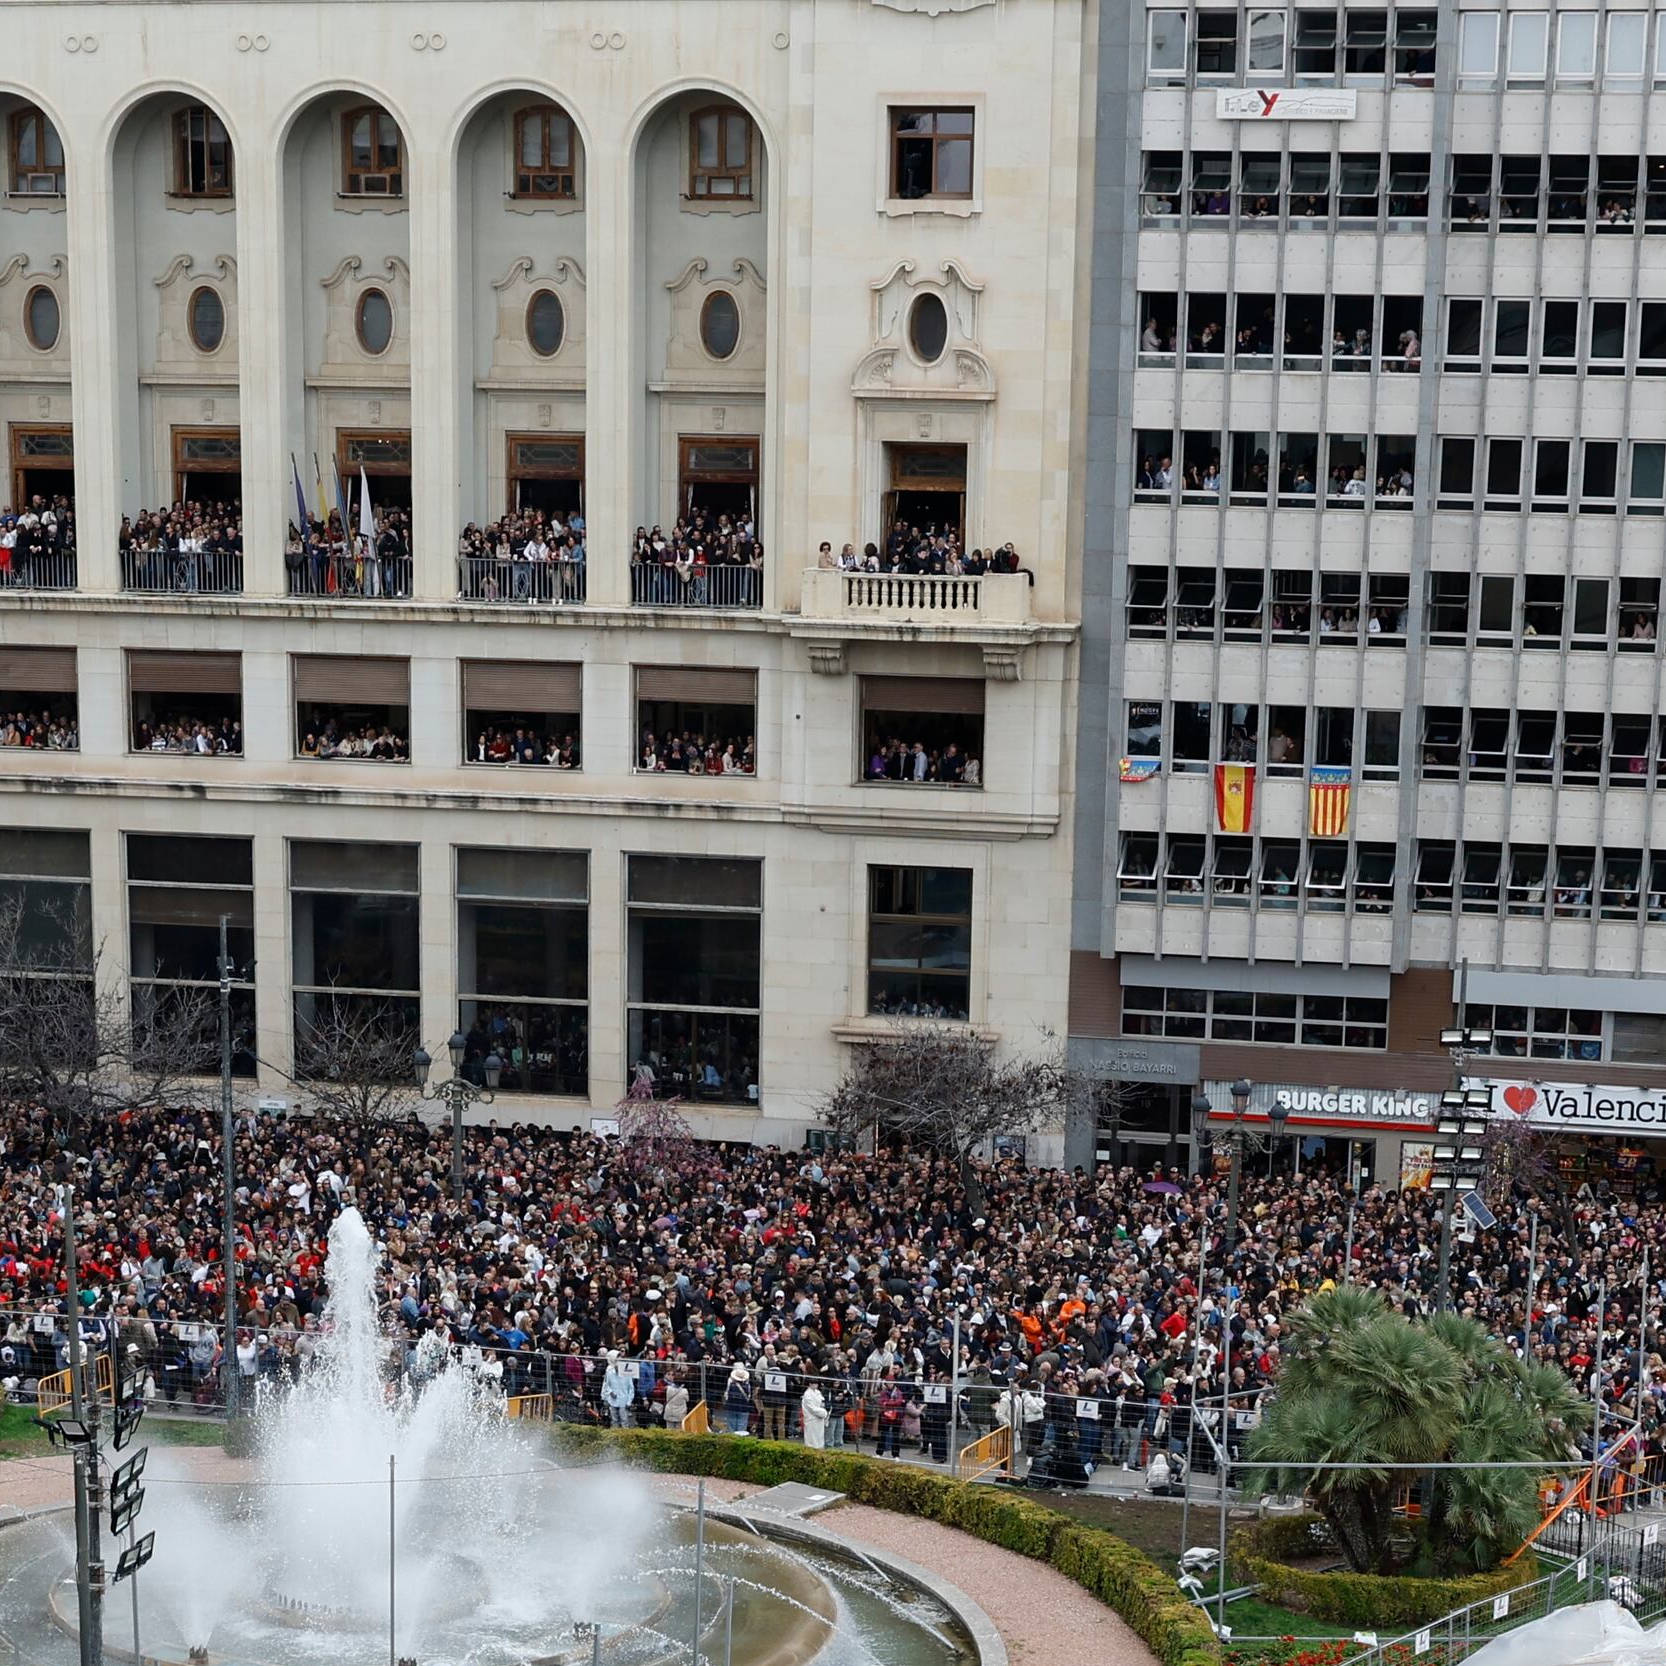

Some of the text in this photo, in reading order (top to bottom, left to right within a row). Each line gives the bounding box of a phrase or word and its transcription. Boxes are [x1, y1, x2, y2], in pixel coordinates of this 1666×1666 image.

[1132, 1062, 1178, 1076] BAYARRI
[1276, 1090, 1429, 1118] BURGER KING
